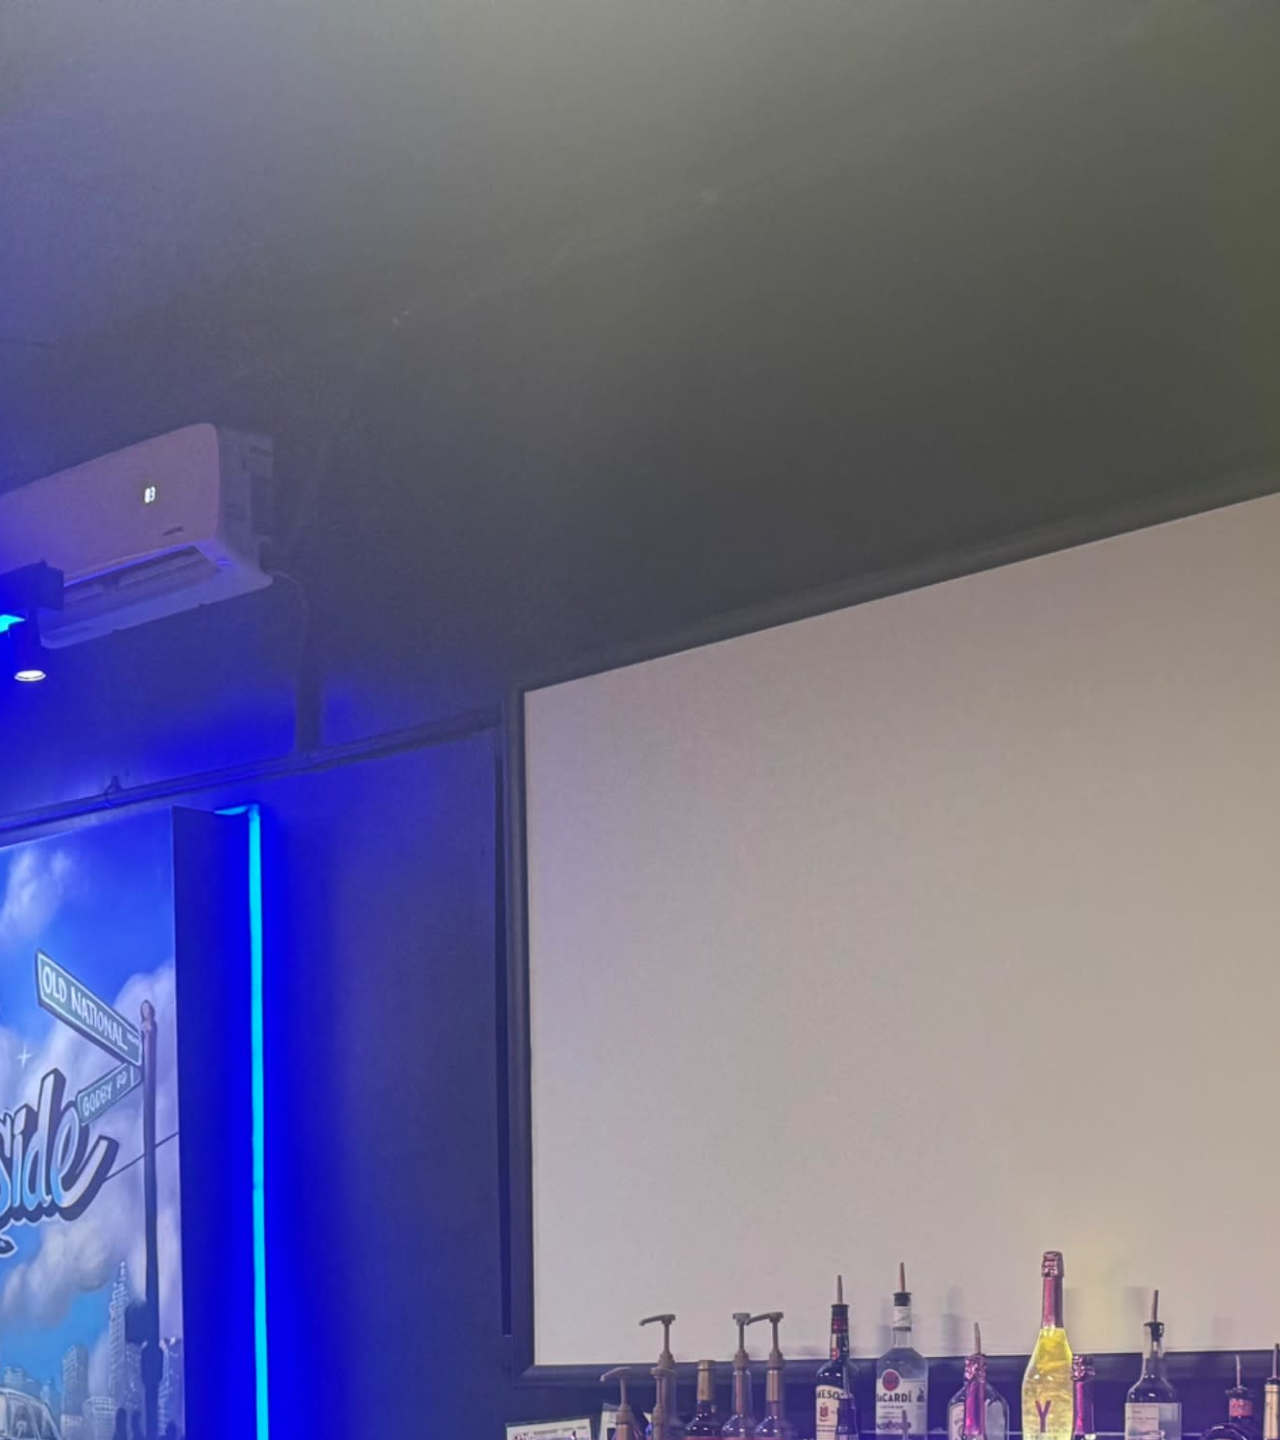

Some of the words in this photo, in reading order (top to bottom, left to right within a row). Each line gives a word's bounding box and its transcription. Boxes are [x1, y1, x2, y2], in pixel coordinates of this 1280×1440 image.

[42, 967, 67, 1003] OLD
[71, 987, 128, 1051] NATIONAL
[82, 1082, 113, 1117] GODBY
